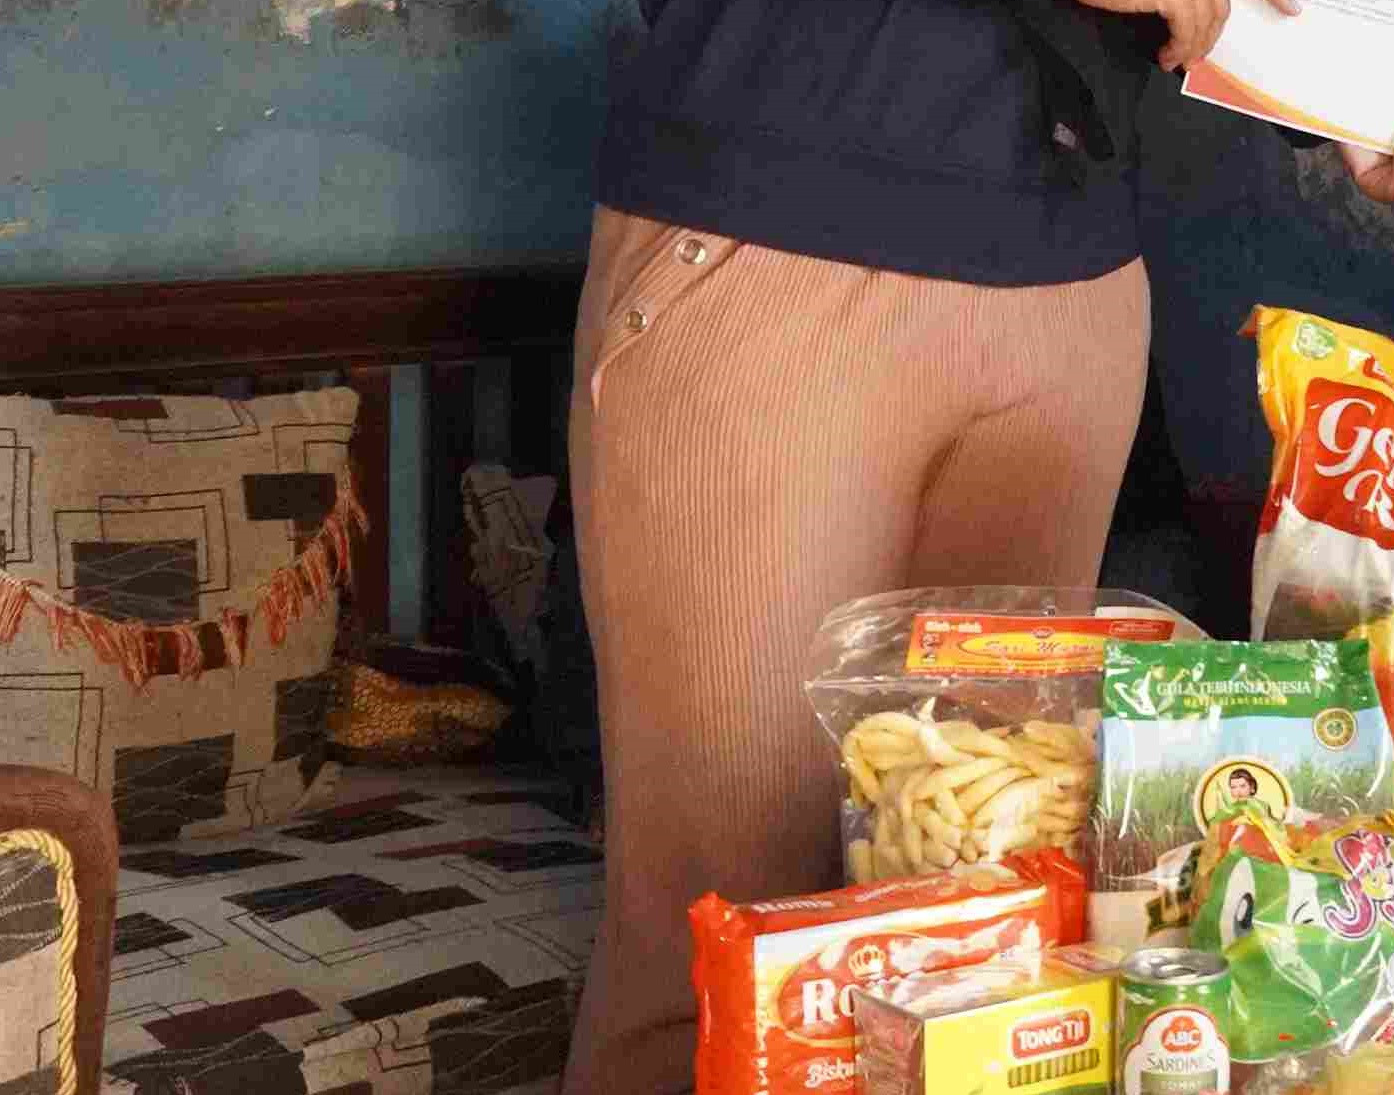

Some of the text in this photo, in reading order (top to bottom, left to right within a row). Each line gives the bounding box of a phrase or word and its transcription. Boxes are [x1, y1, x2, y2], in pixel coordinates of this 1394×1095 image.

[1017, 1024, 1064, 1050] TONG
[1163, 1027, 1201, 1045] ABC
[1146, 1050, 1217, 1073] SARDINS
